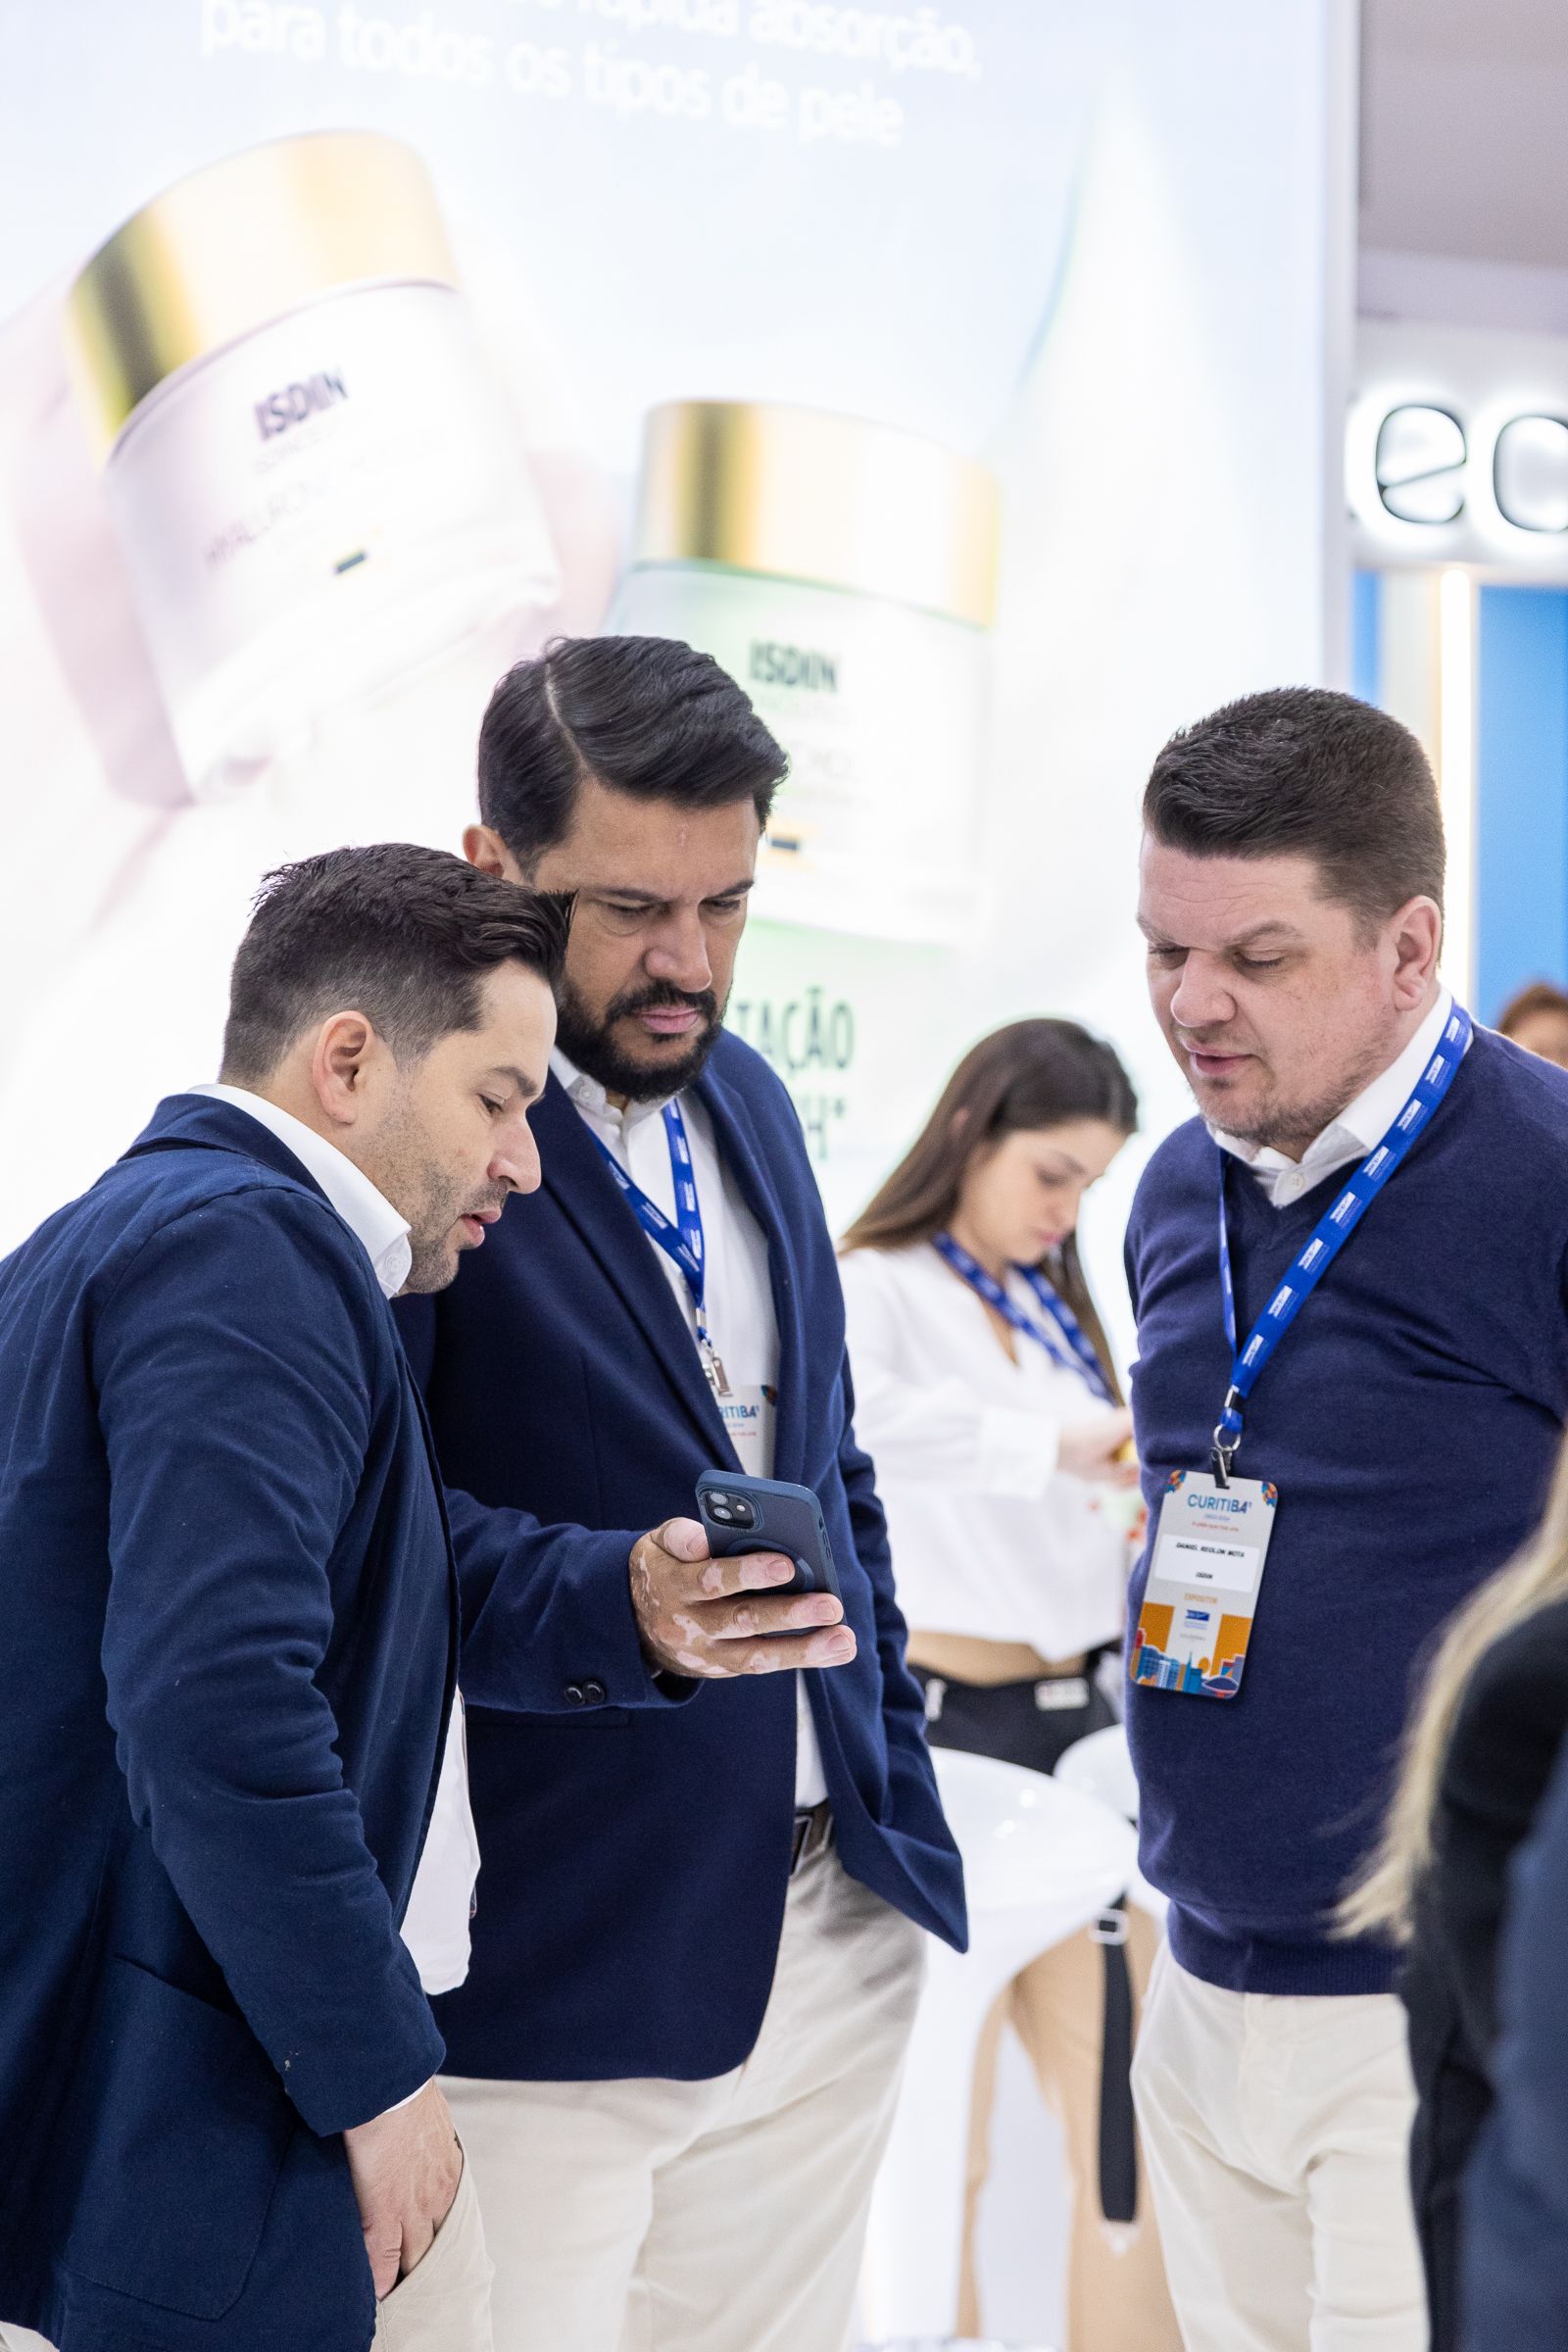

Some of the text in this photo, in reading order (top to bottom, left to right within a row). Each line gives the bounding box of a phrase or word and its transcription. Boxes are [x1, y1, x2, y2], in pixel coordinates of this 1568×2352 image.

[202, 0, 906, 145] para todos os tipos de pele
